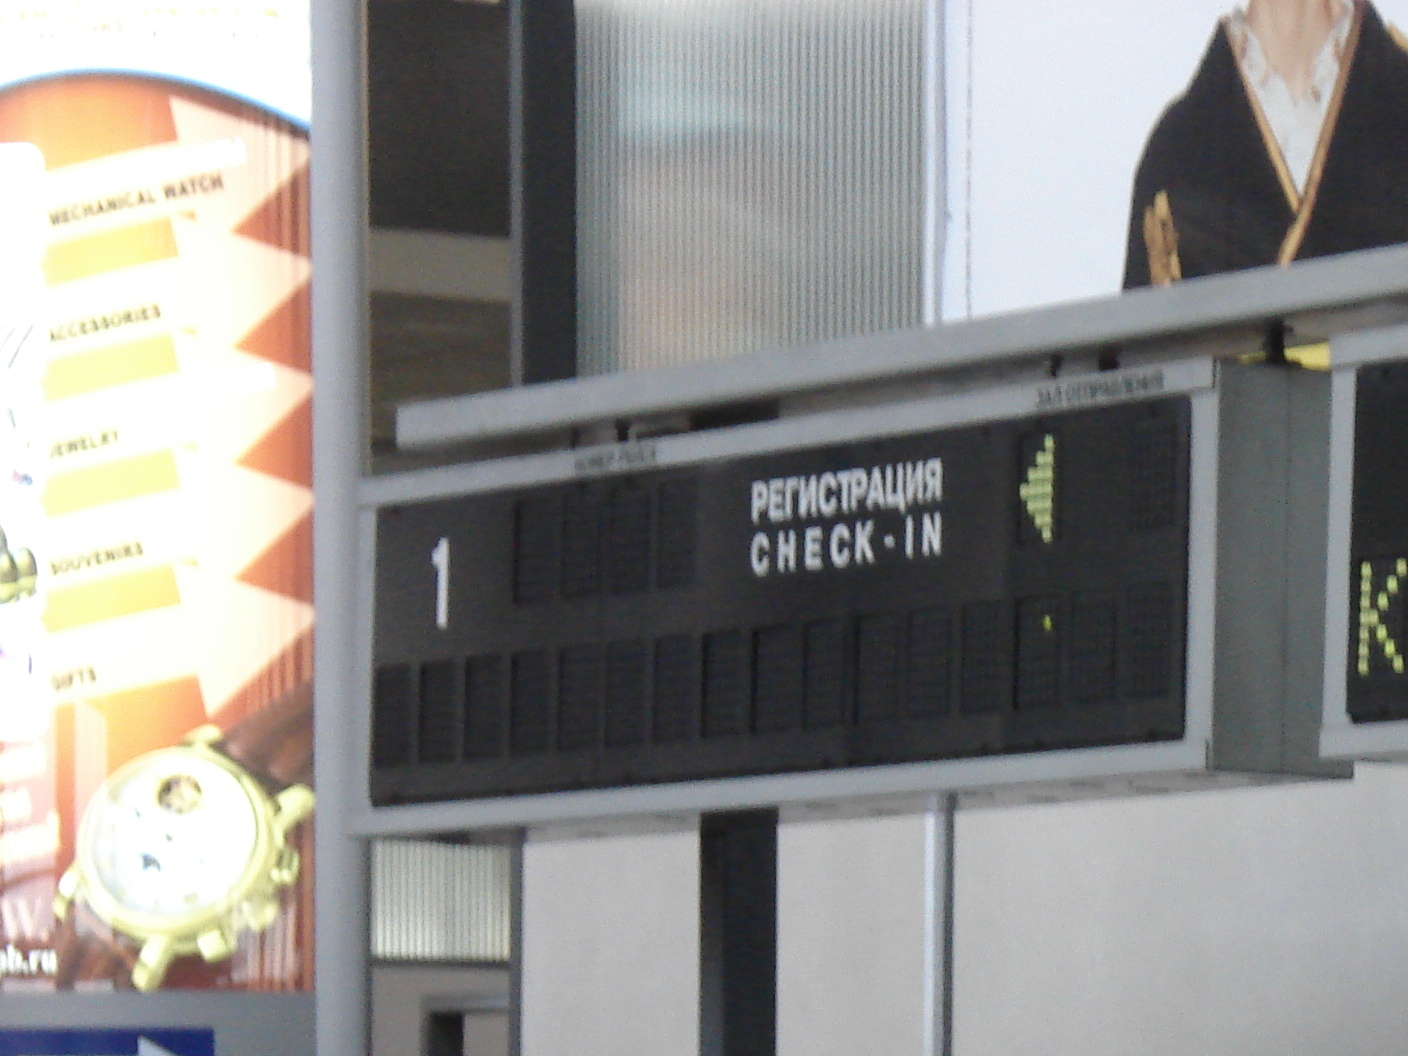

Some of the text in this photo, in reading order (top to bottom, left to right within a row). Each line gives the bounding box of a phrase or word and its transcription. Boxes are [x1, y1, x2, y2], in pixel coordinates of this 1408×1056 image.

[49, 172, 225, 227] MECHANICAL WATCH
[49, 304, 162, 342] ACCESSORIES
[751, 457, 943, 524] РЕГИСТРАЦИЯ
[431, 537, 450, 630] 1
[51, 667, 97, 692] GIFTS
